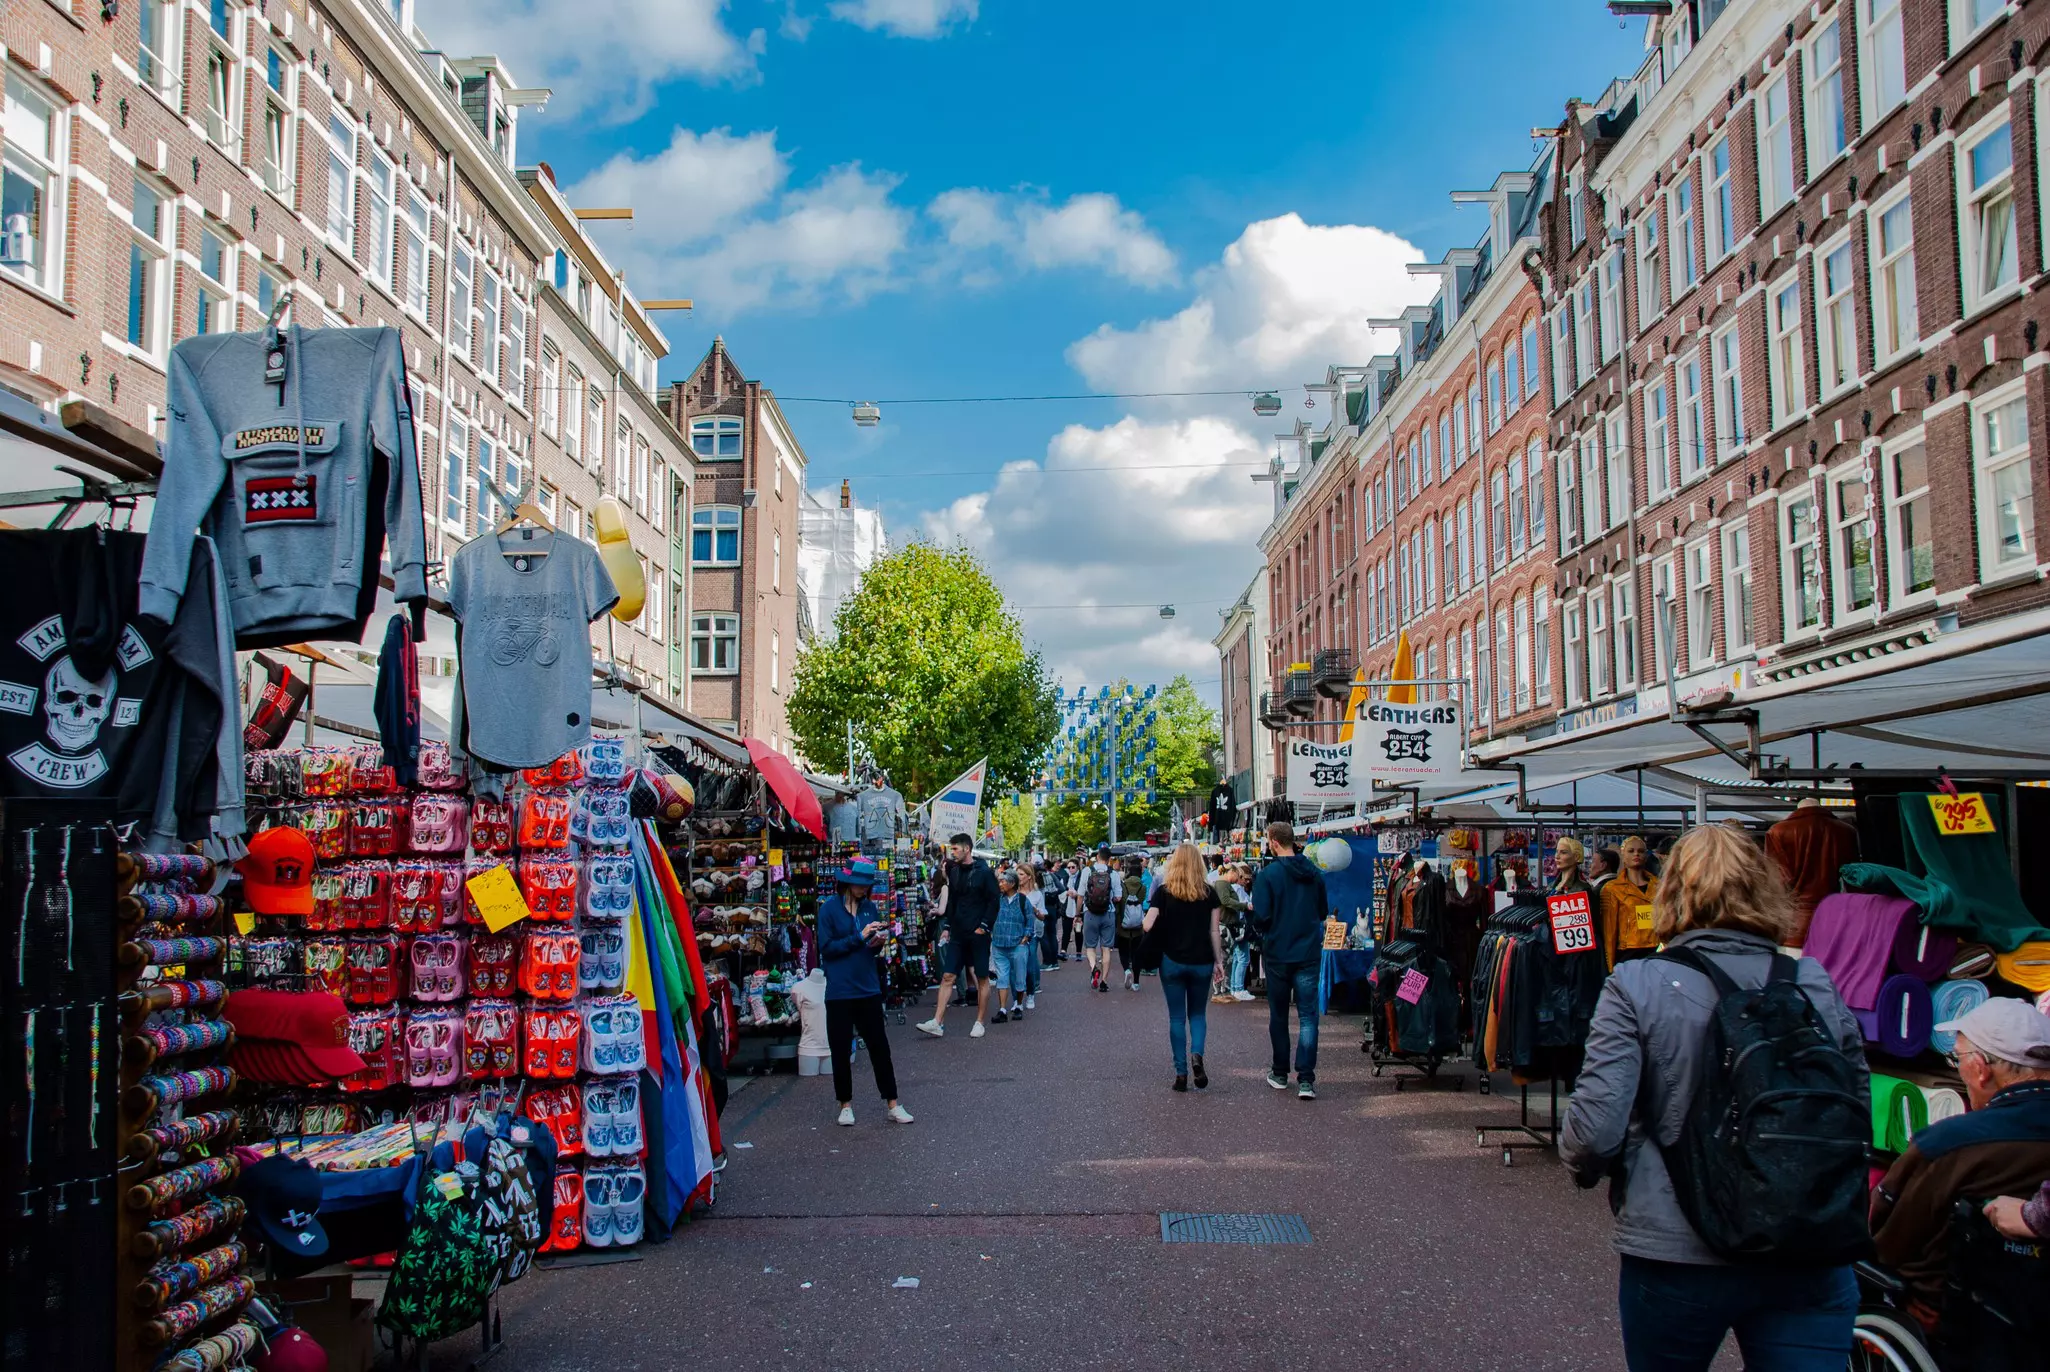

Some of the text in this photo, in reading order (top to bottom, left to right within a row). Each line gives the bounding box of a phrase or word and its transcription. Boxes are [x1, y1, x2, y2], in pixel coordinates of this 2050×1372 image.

[1359, 704, 1456, 724] LEATHERS
[1410, 733, 1424, 741] CUYP
[1389, 741, 1424, 757] 254
[37, 758, 89, 780] CREW
[1316, 772, 1345, 784] 254
[1550, 898, 1586, 915] SALE
[1563, 927, 1589, 948] 99
[1403, 976, 1421, 991] CUIR
[1406, 969, 1427, 984] LEER
